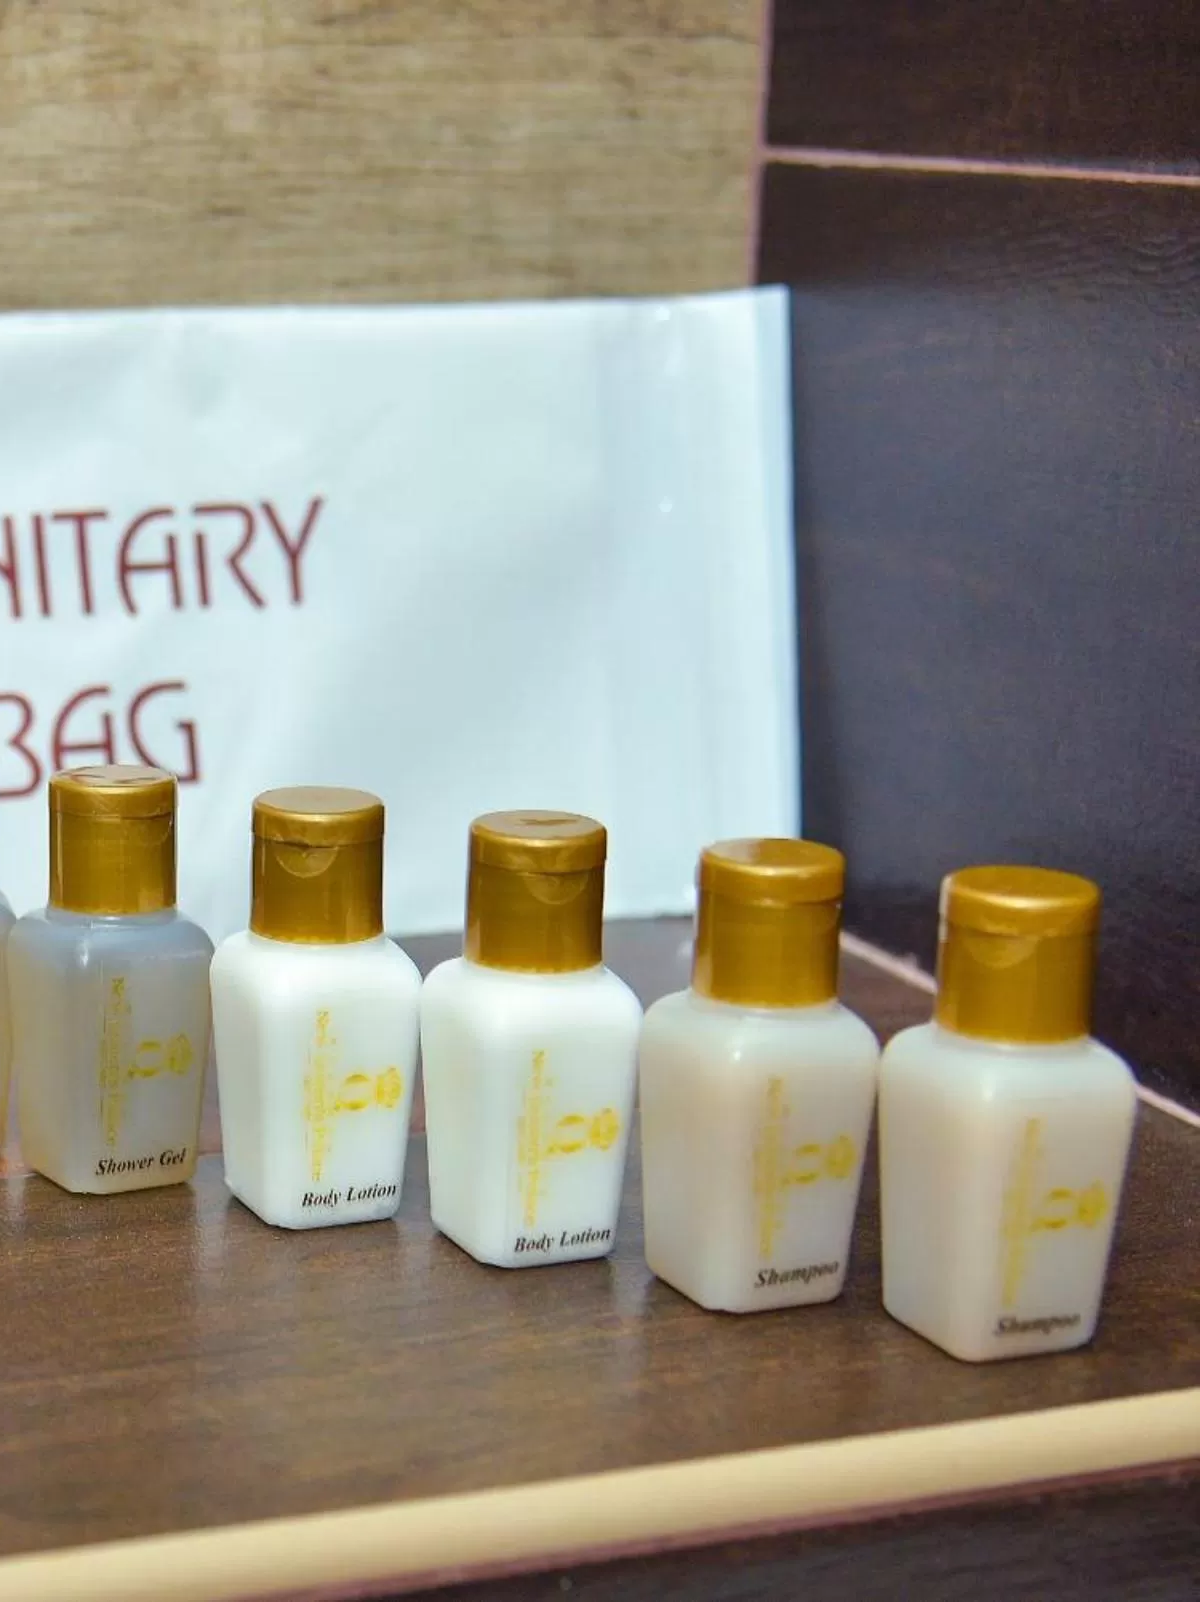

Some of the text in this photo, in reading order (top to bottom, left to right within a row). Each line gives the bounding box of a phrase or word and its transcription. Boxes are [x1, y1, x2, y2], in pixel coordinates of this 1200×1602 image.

[95, 1147, 187, 1176] Shower Gel
[302, 1183, 397, 1208] Body Lotion
[514, 1227, 611, 1254] Body Lotion
[754, 1261, 839, 1288] Shampoo
[992, 1314, 1081, 1338] Shampoo
